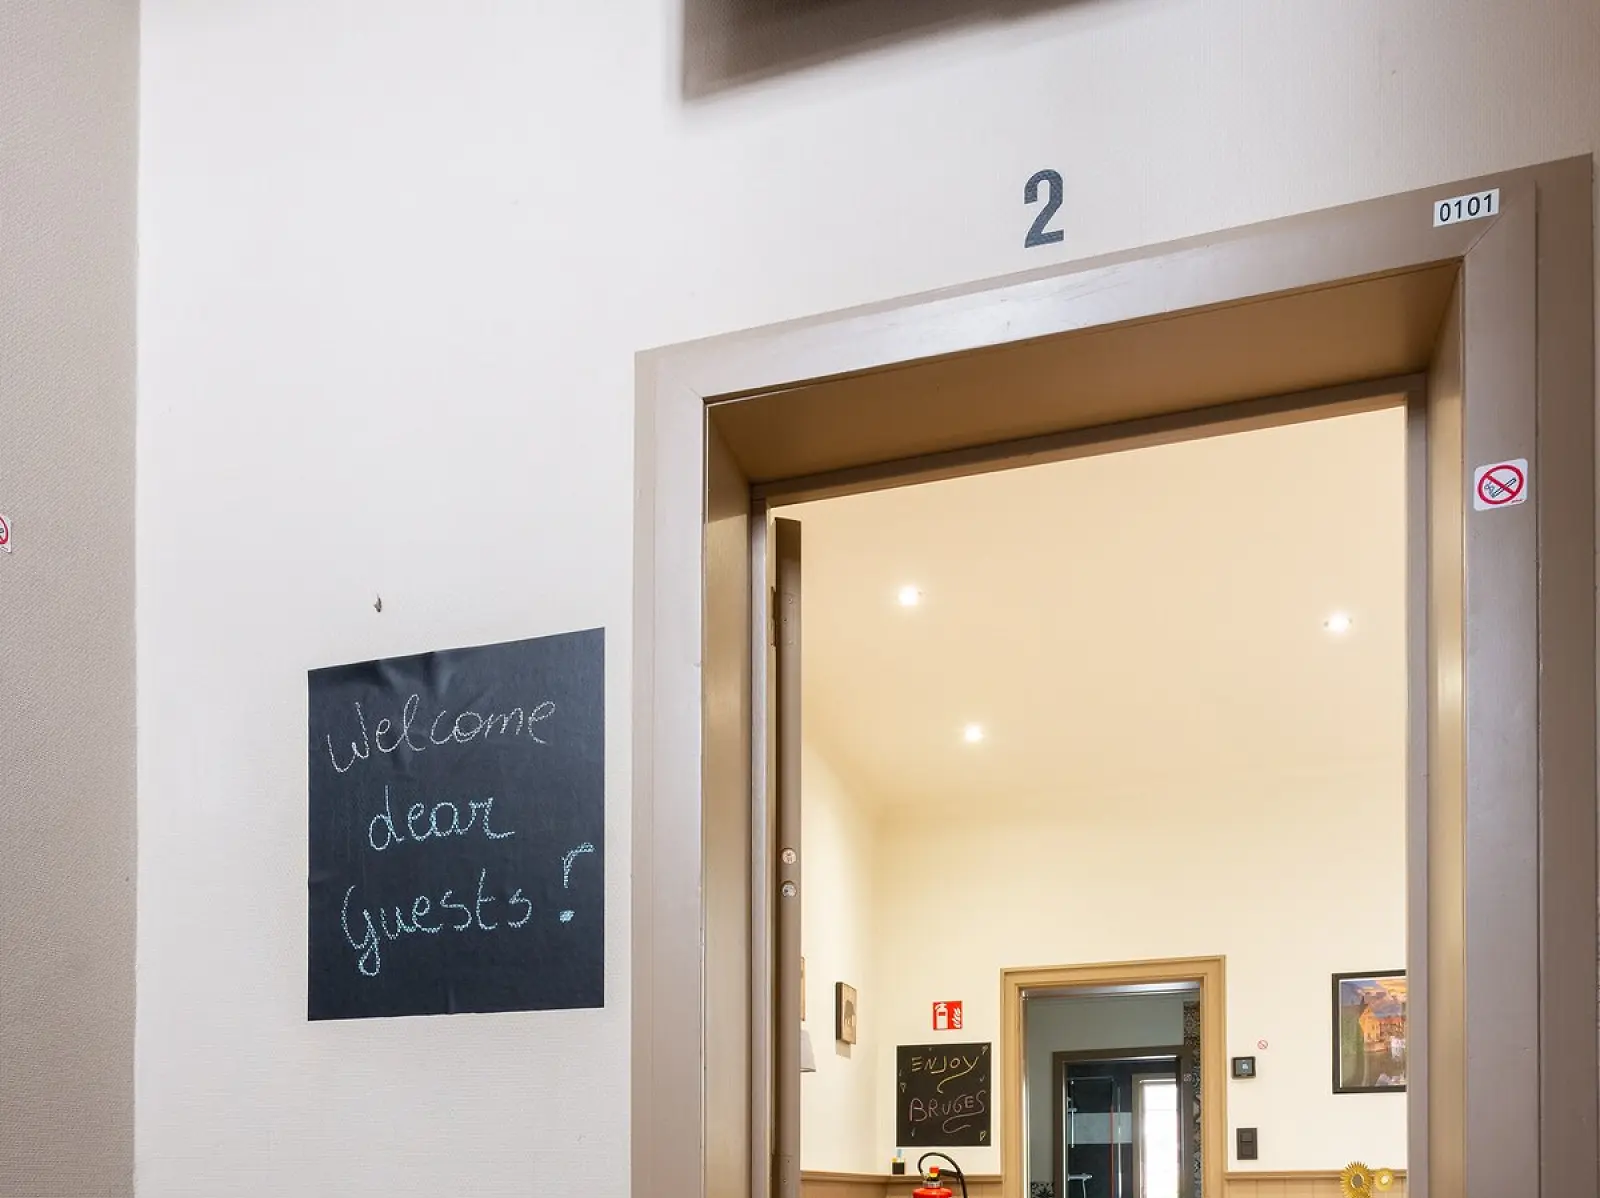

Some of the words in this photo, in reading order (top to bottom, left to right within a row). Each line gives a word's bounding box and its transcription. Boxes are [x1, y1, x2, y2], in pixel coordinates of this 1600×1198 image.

[1024, 168, 1064, 248] 2
[1439, 193, 1493, 222] 0101
[327, 693, 556, 773] Welcome
[368, 785, 515, 850] dear
[911, 1055, 979, 1094] ENJOY
[909, 1090, 986, 1134] BRUGES
